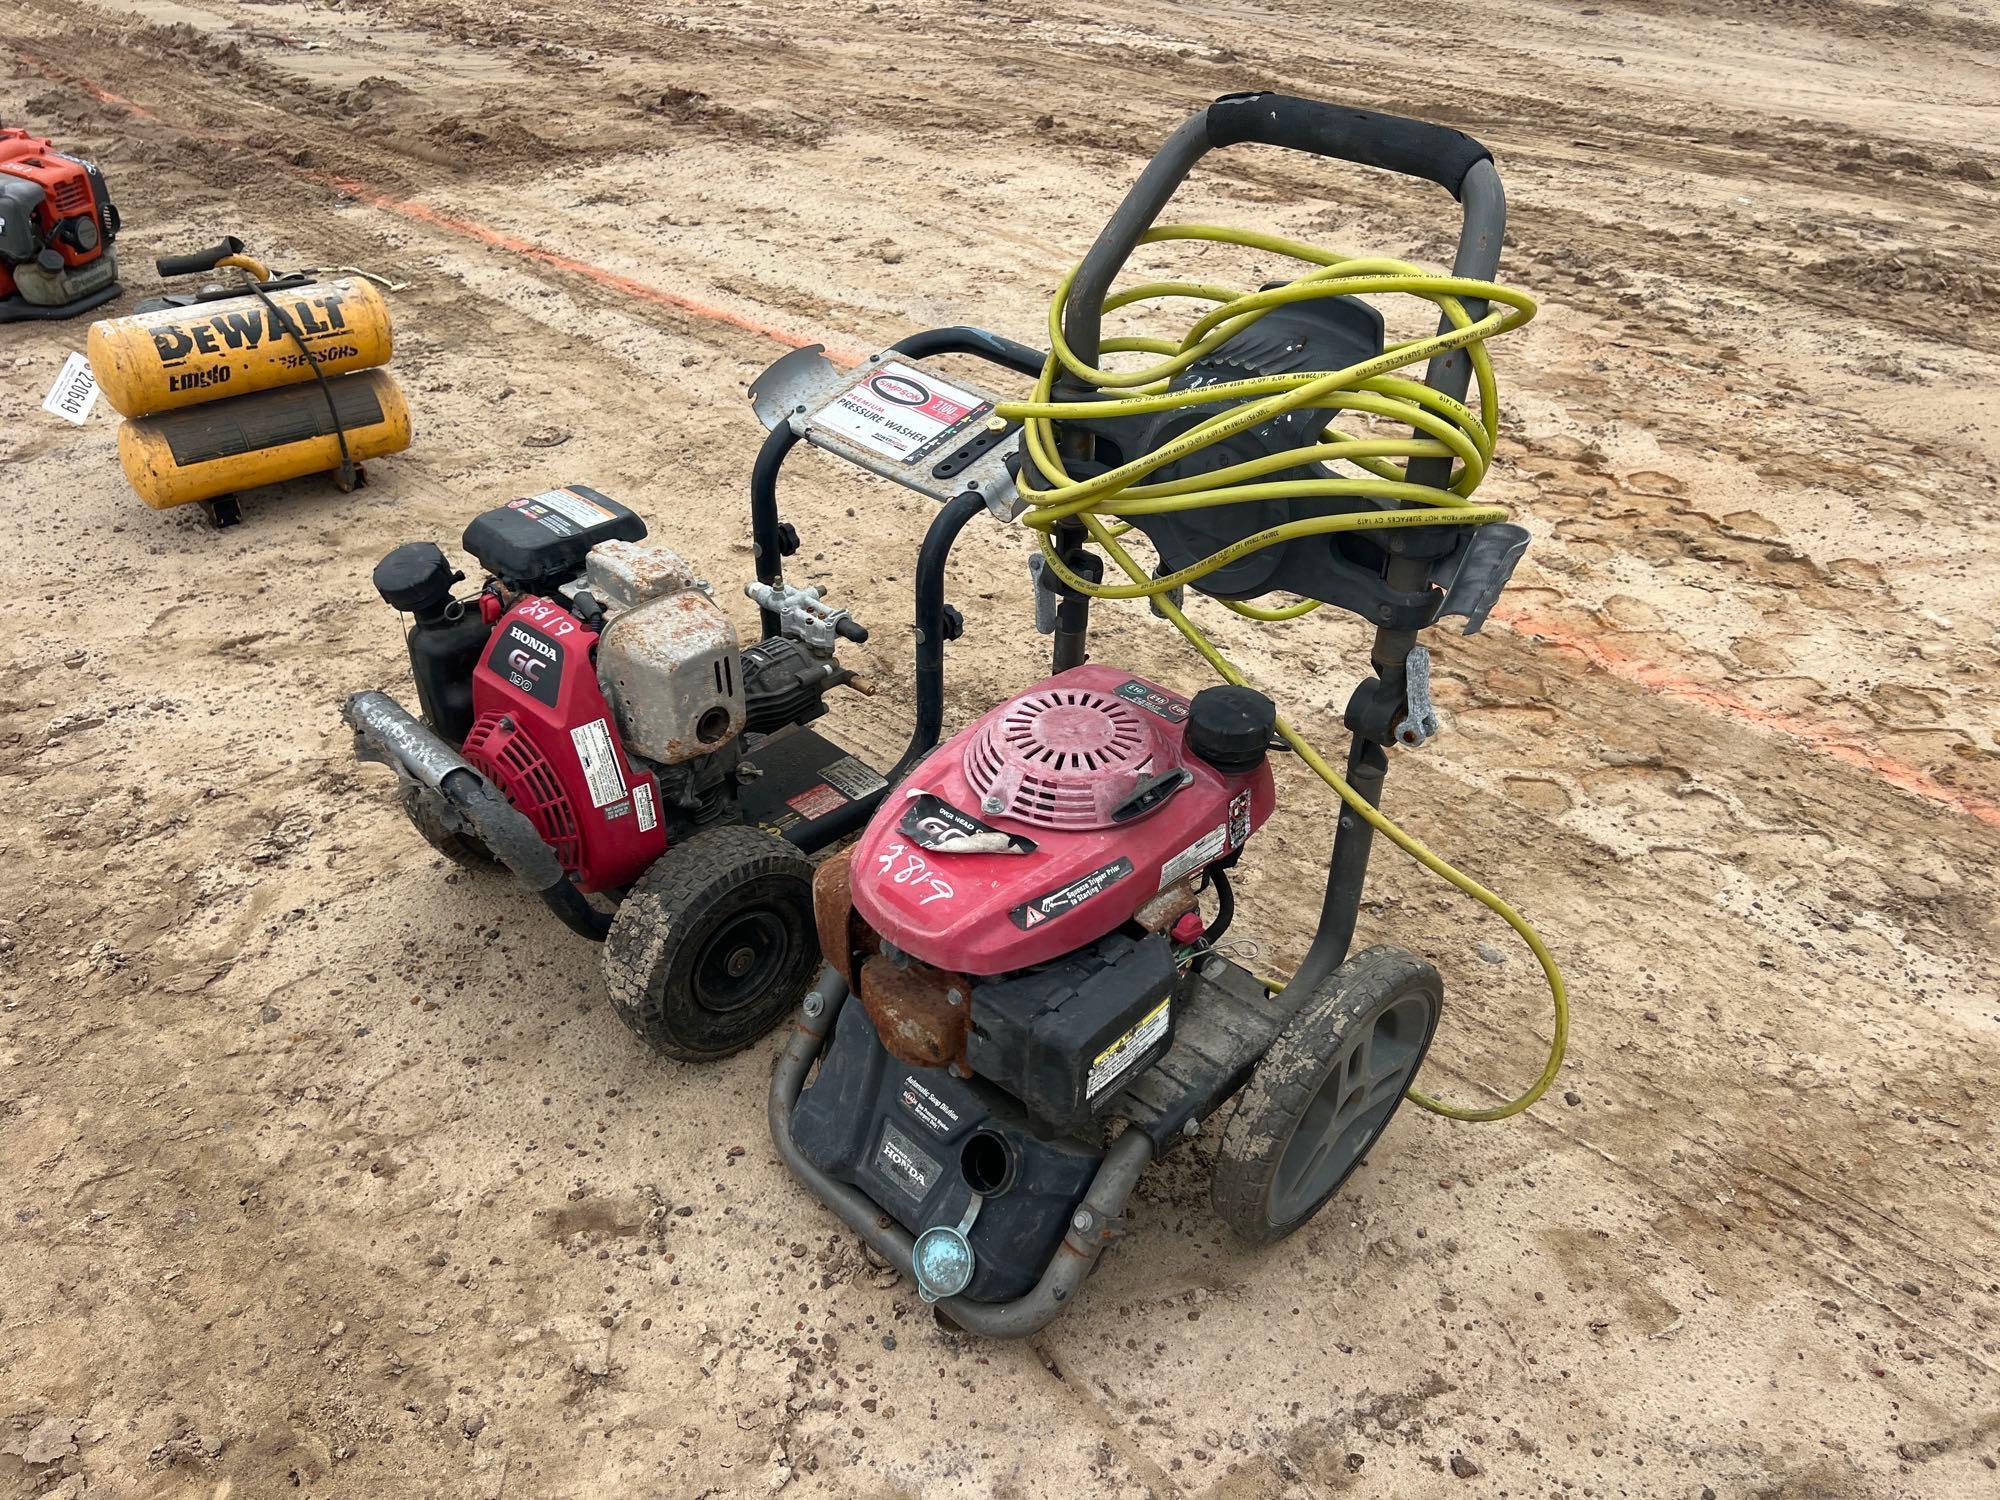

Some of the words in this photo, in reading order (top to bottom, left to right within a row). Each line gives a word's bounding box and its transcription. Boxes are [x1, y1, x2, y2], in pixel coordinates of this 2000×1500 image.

[150, 296, 346, 361] DEWALT
[1385, 349, 1421, 366] SURFACES
[1423, 344, 1439, 354] HOT
[61, 371, 96, 414] 220649
[878, 380, 921, 401] SIMPSON
[1209, 383, 1228, 392] AWAY
[847, 393, 885, 413] PREMIUM
[932, 400, 958, 414] 3100
[837, 398, 885, 423] PRESSURE
[884, 419, 928, 442] WASHER
[1388, 514, 1422, 523] SURFACES
[510, 626, 556, 662] HONDA
[508, 649, 547, 682] GC
[509, 672, 532, 692] 190
[954, 816, 974, 830] HEAD
[1066, 883, 1090, 899] Squeeze
[1088, 872, 1108, 888] Trigger
[1106, 864, 1120, 876] Prior
[1077, 886, 1100, 902] Starting
[906, 1076, 930, 1098] Automatic
[928, 1093, 942, 1106] Soap
[939, 1102, 959, 1121] Dilution
[883, 1144, 928, 1187] HONDA
